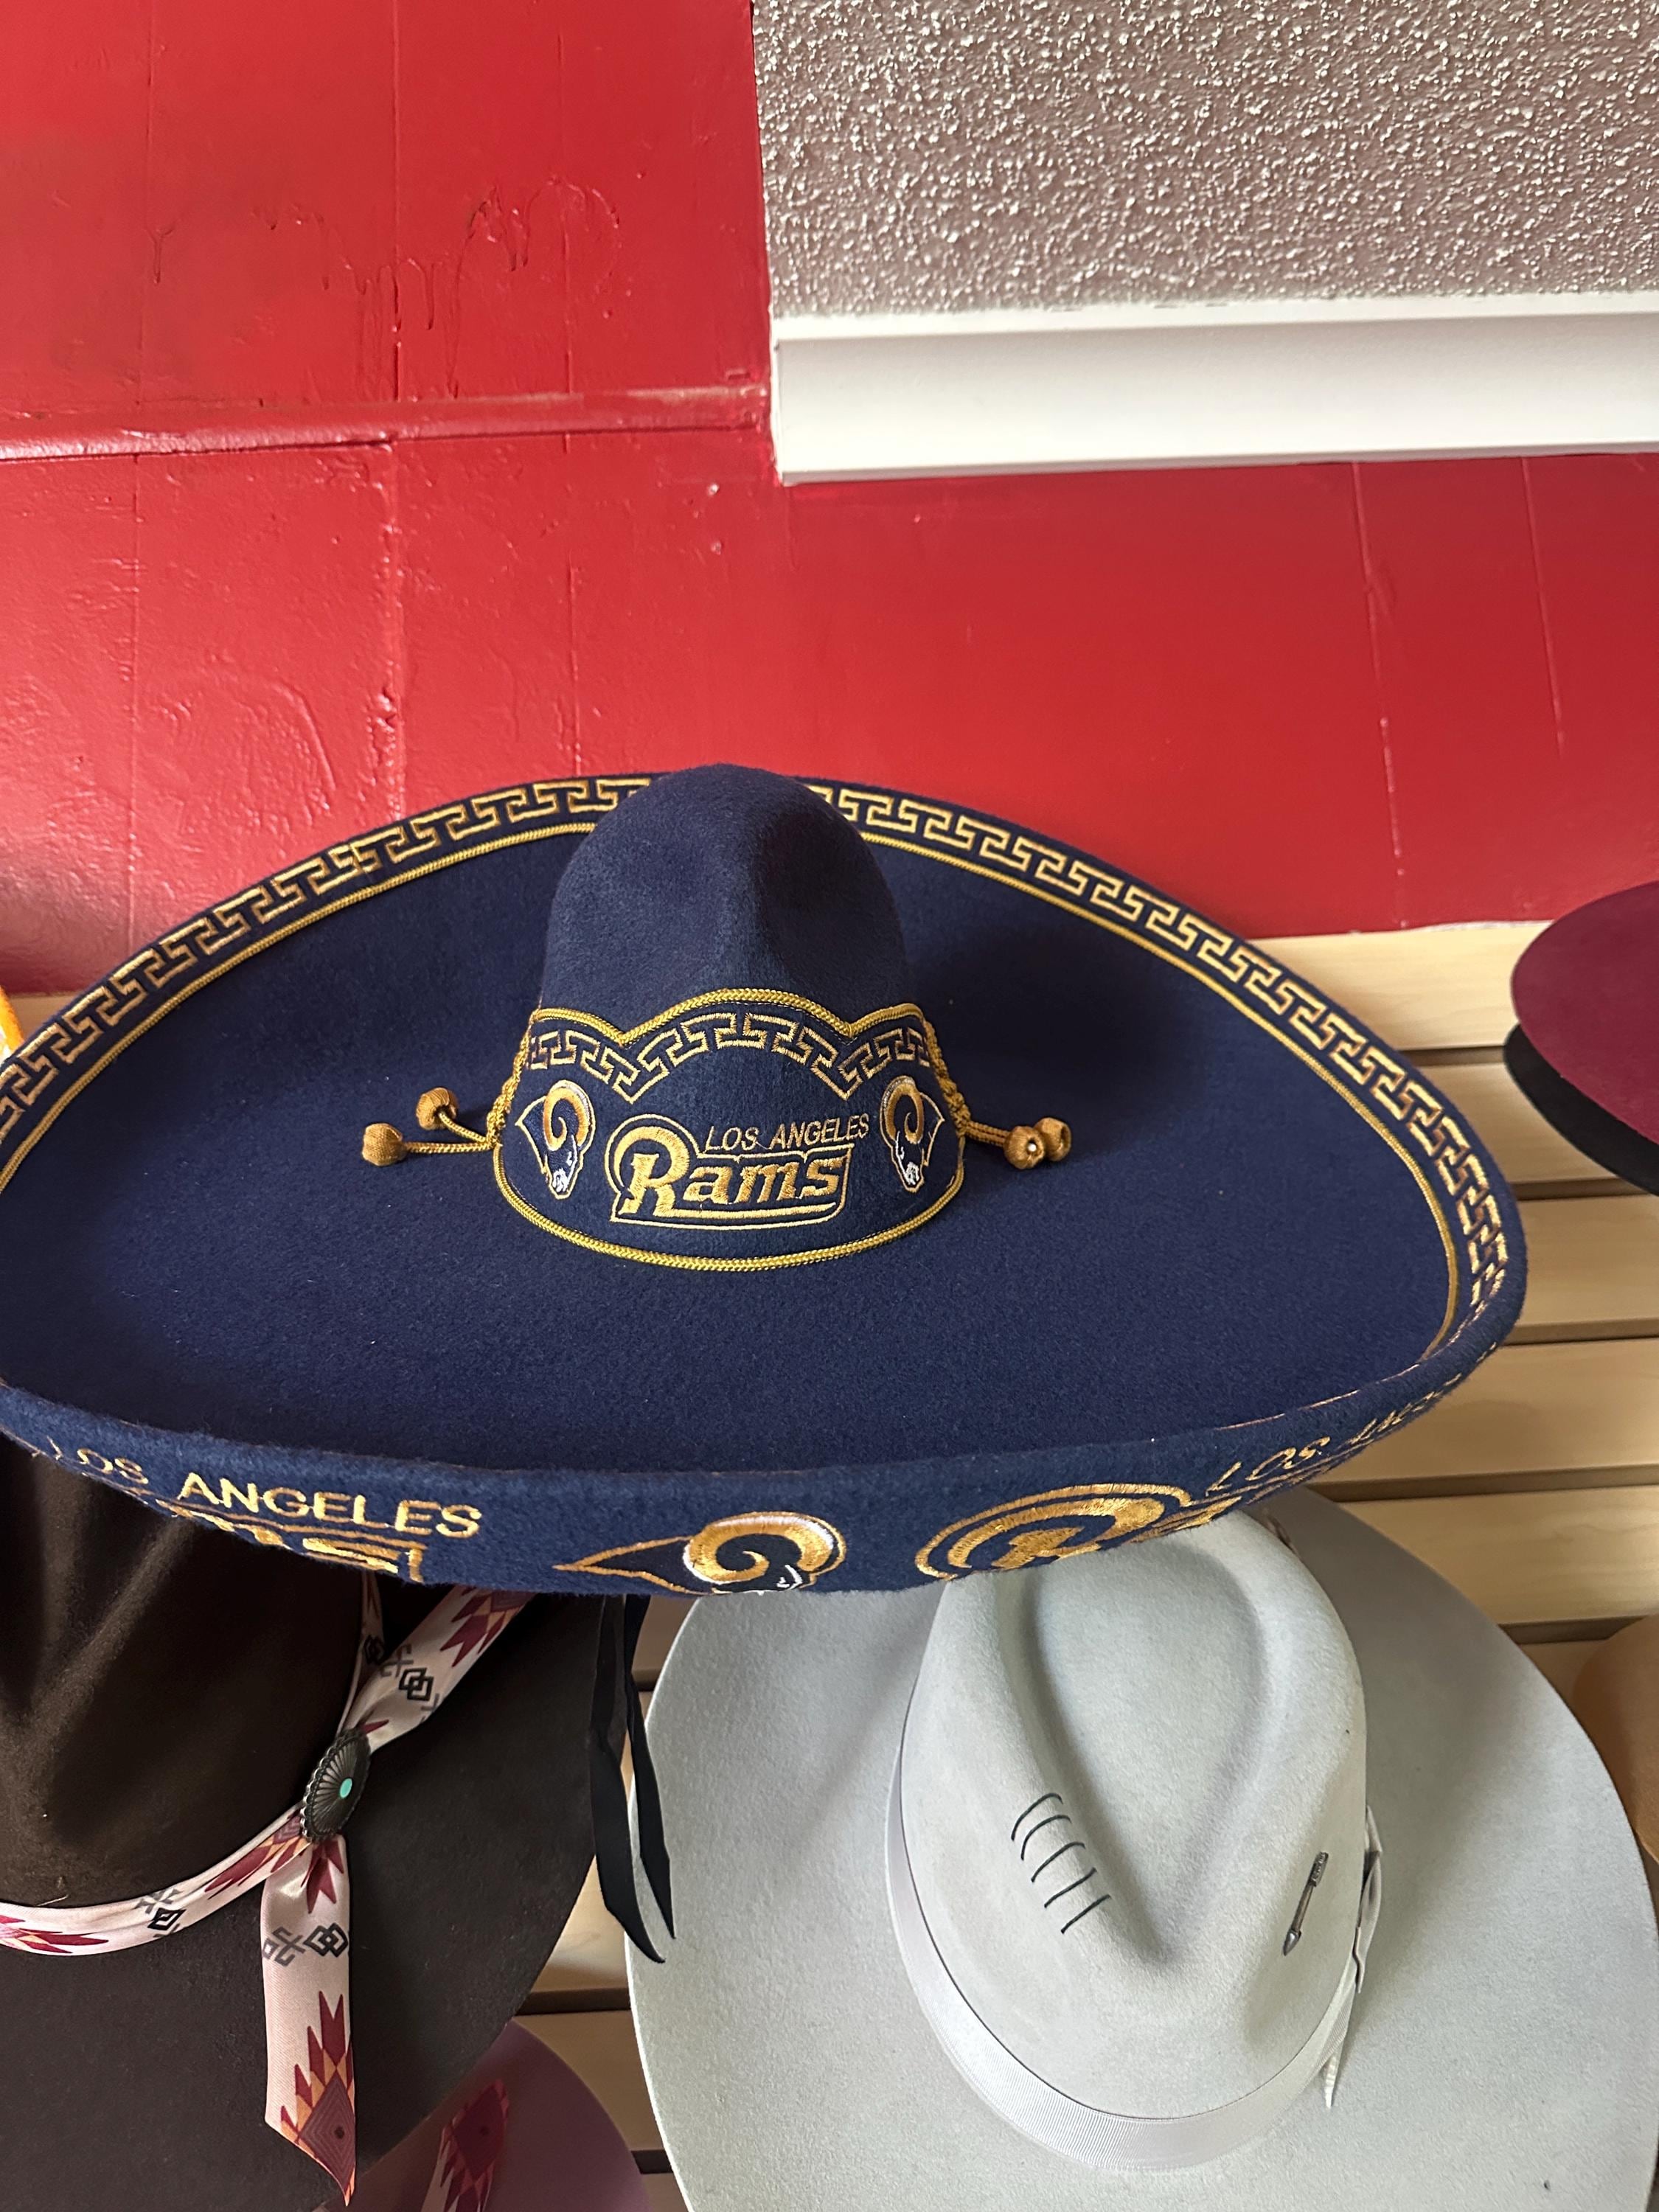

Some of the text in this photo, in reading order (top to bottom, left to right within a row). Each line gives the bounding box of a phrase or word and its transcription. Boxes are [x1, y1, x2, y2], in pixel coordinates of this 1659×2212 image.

[703, 1113, 869, 1154] LOS ANGELES
[613, 1125, 848, 1218] Rams
[176, 1472, 482, 1539] ANGELES
